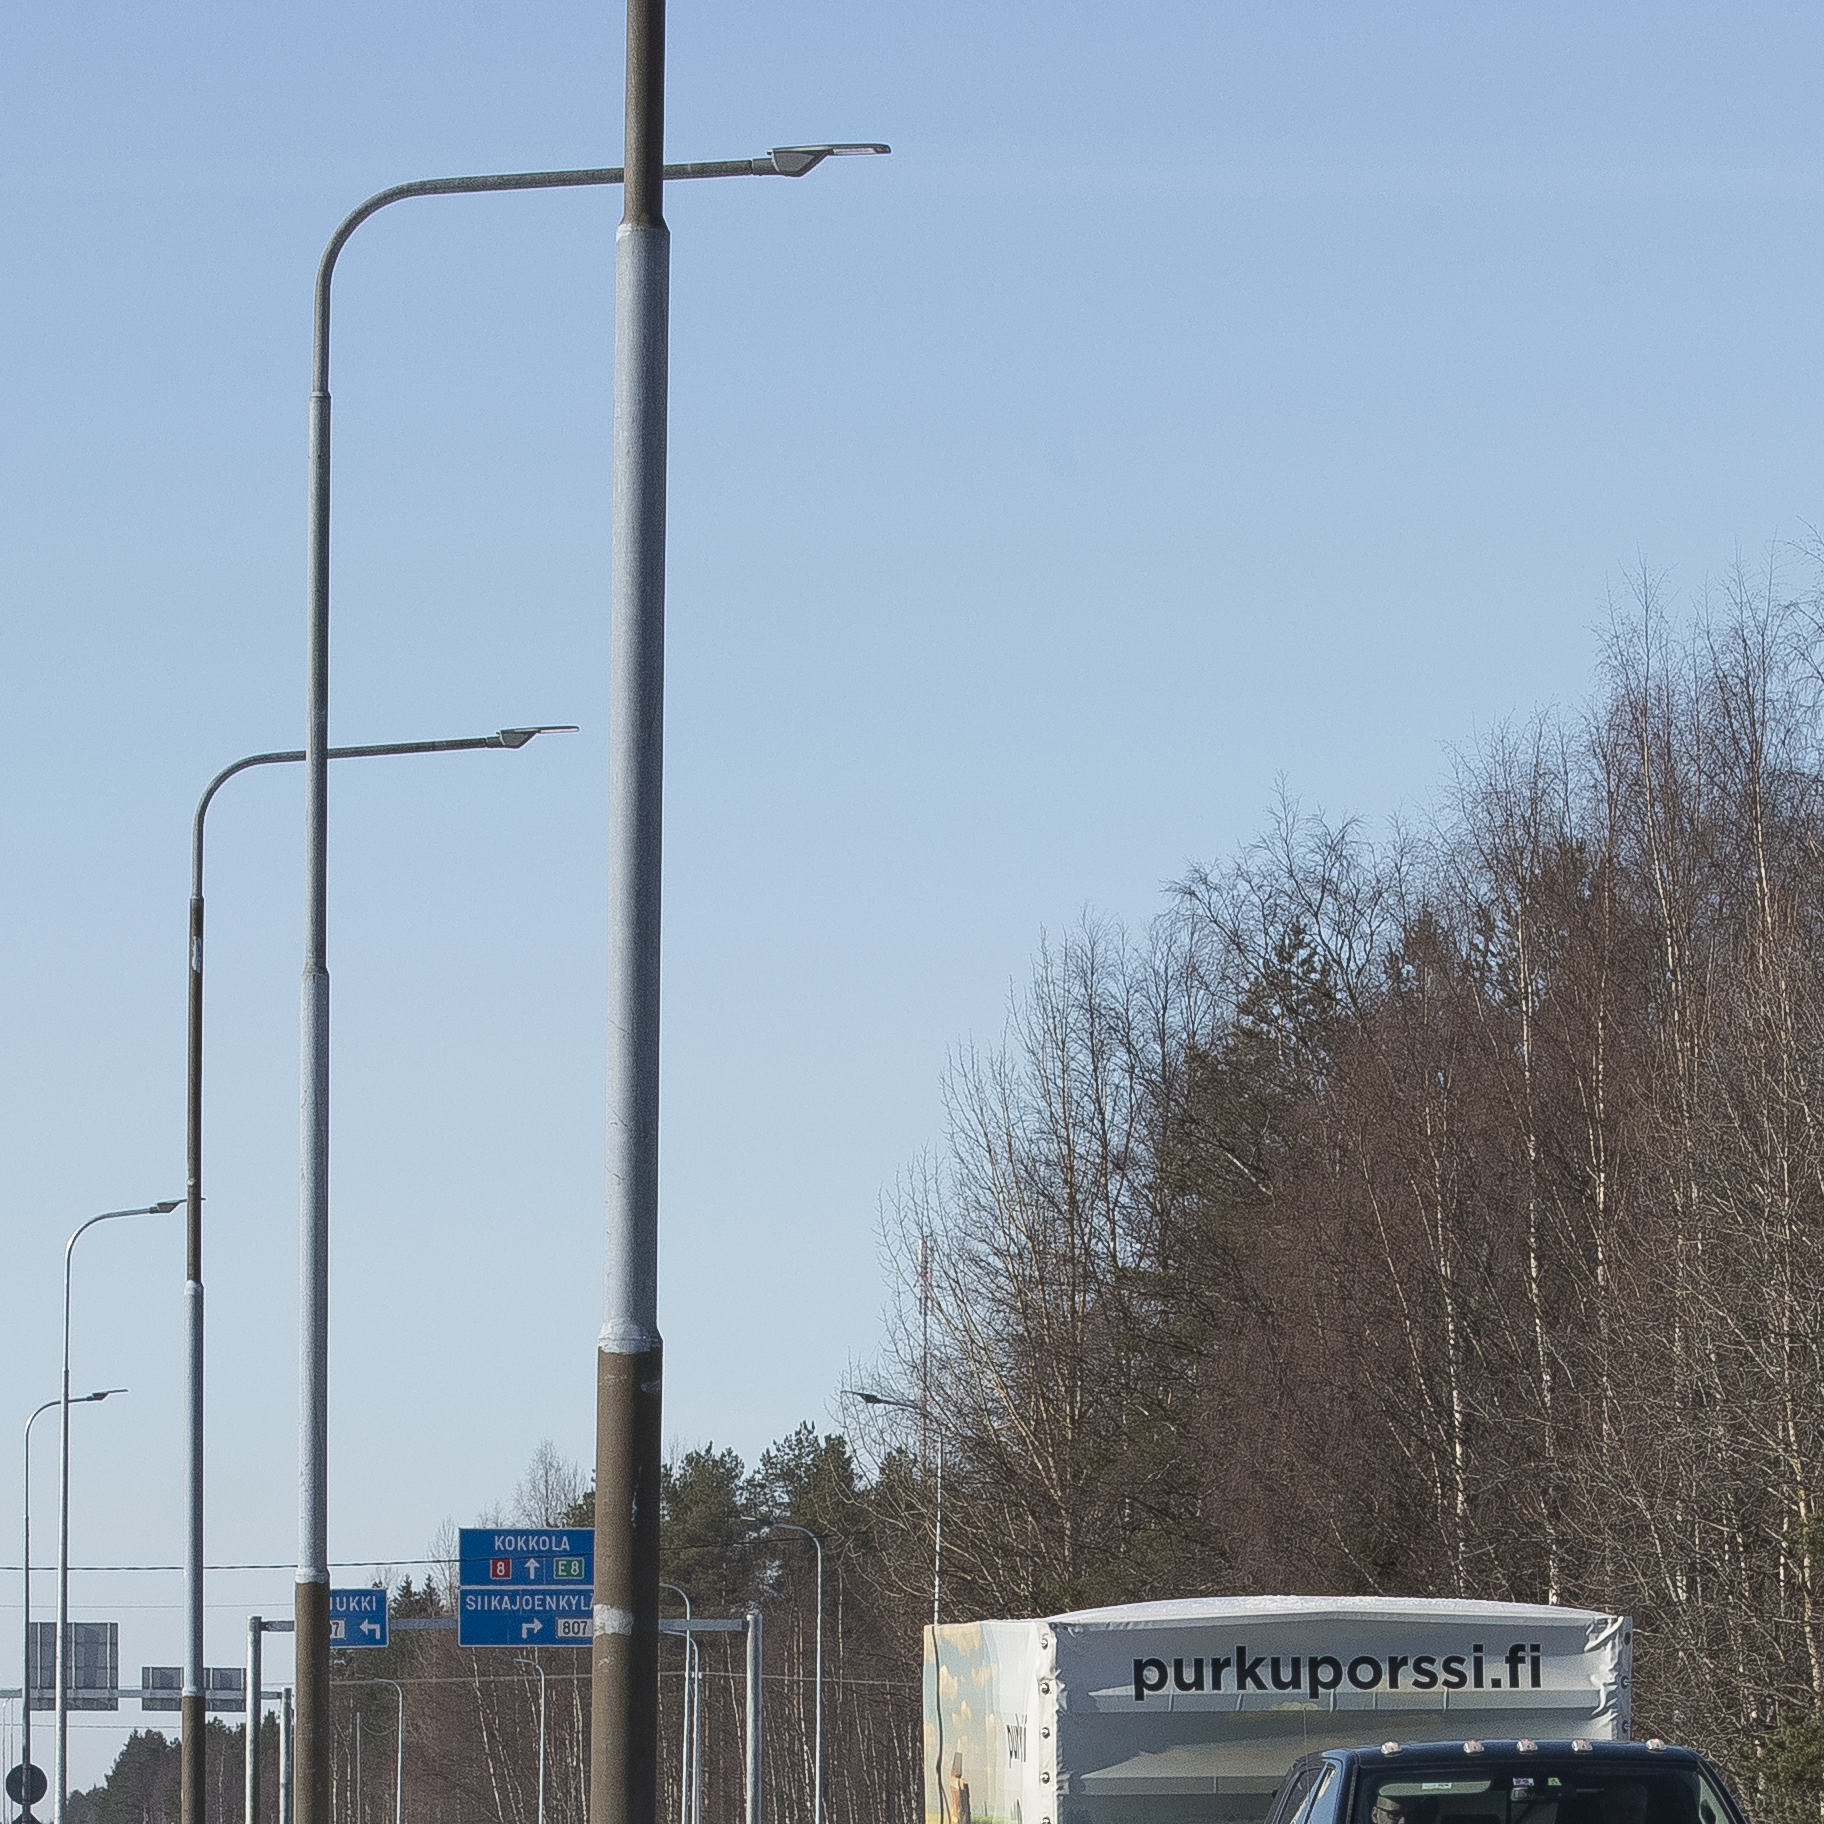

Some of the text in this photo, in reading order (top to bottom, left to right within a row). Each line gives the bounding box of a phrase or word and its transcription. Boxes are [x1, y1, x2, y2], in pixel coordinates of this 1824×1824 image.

[494, 1535, 570, 1551] KOKKOLA
[496, 1561, 505, 1576] 8
[330, 1596, 376, 1611] UKKI
[562, 1620, 588, 1636] 807
[1133, 1643, 1542, 1702] purkuporssi.fi
